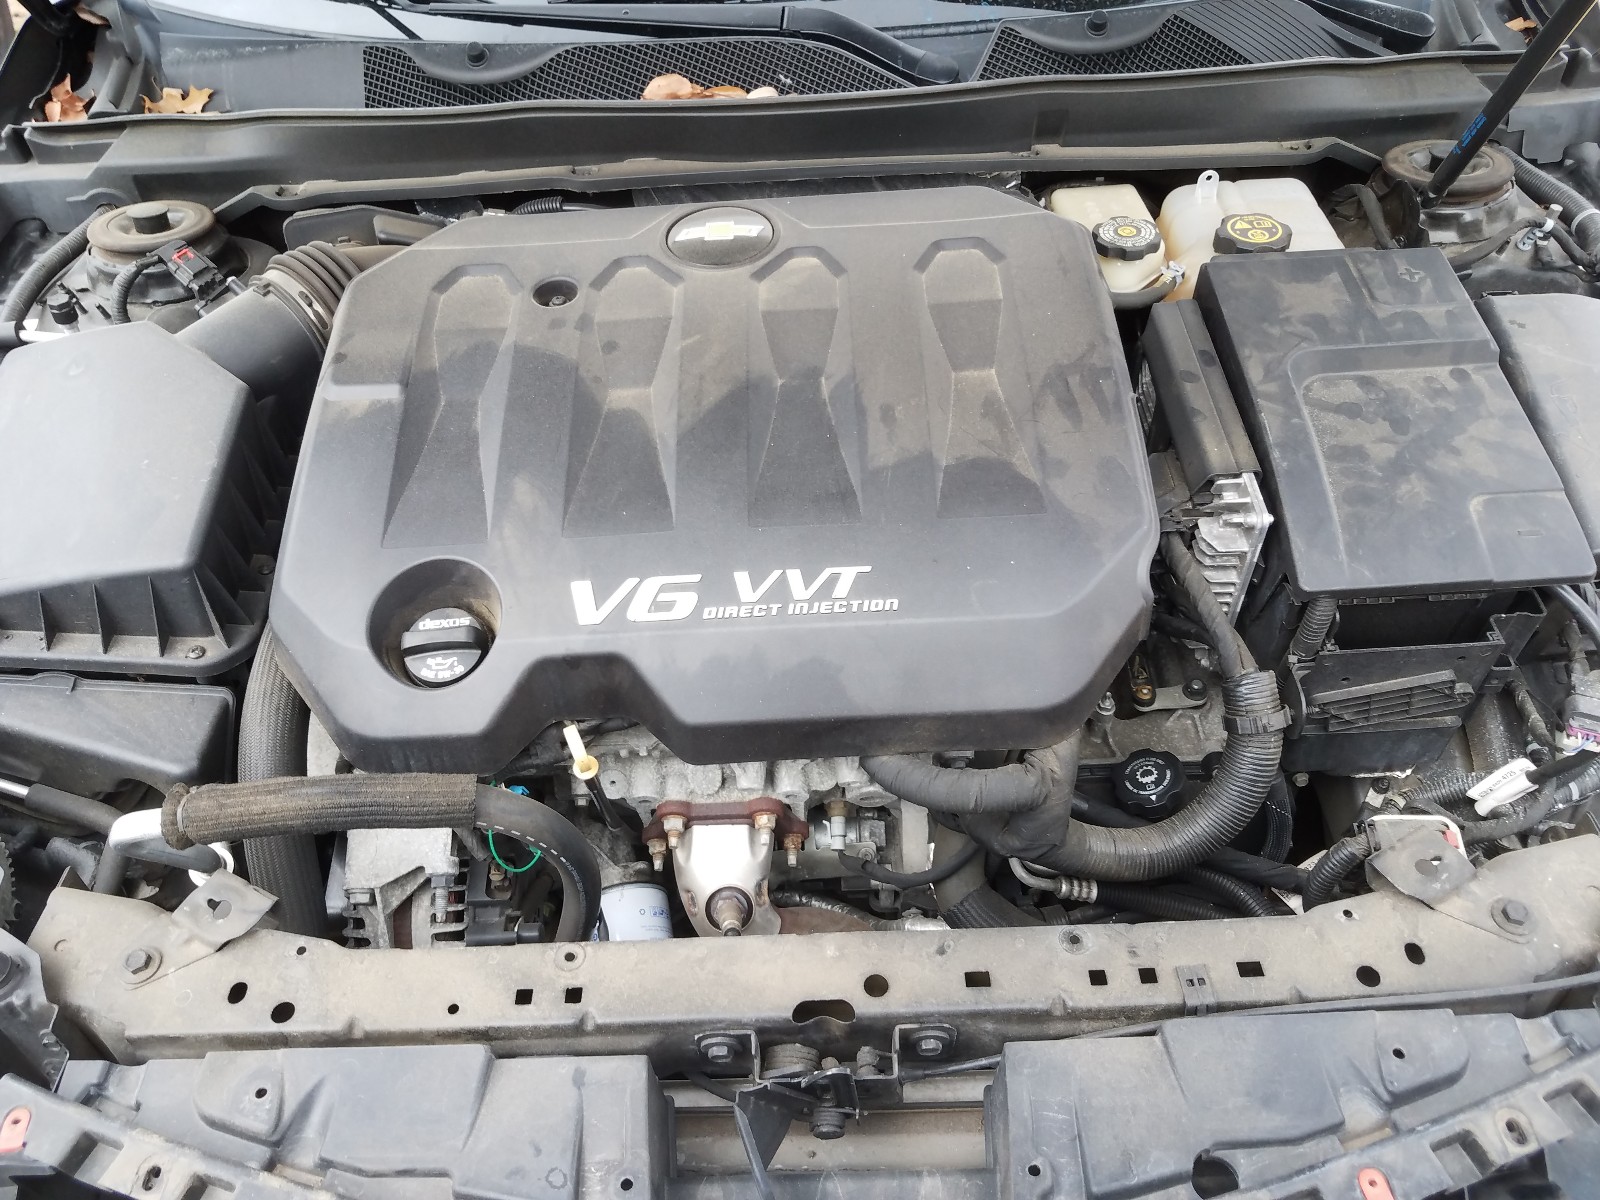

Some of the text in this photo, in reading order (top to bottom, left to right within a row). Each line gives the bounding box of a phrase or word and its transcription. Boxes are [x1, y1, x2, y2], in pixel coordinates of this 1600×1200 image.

[570, 565, 873, 625] V6 VVT
[702, 598, 899, 620] DIRECT INJECTION
[418, 617, 474, 631] dexos
